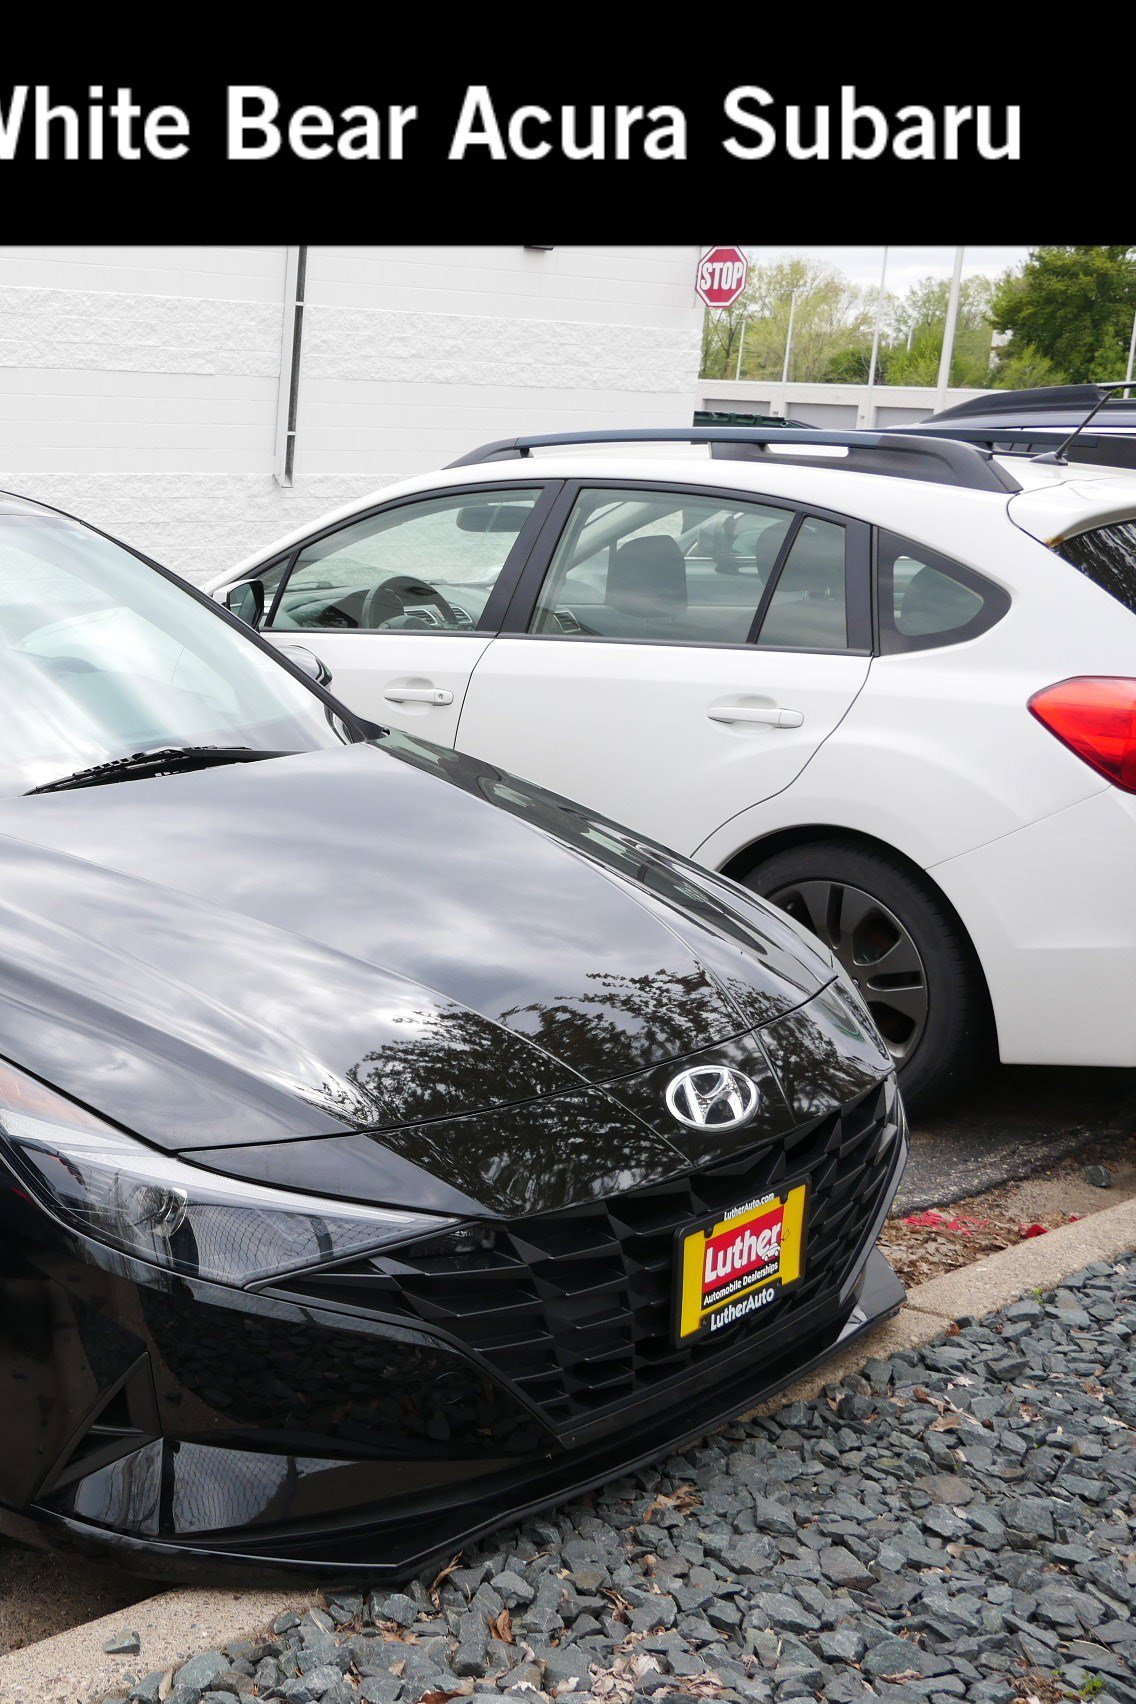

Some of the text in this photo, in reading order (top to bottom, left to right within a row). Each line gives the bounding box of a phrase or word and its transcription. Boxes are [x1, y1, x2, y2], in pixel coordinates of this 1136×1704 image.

[699, 260, 743, 291] STOP
[723, 1192, 775, 1222] LutherAuto.com
[704, 1222, 782, 1284] Luther
[703, 1262, 779, 1306] Automobile Dealerships
[710, 1287, 775, 1332] LutherAuto
